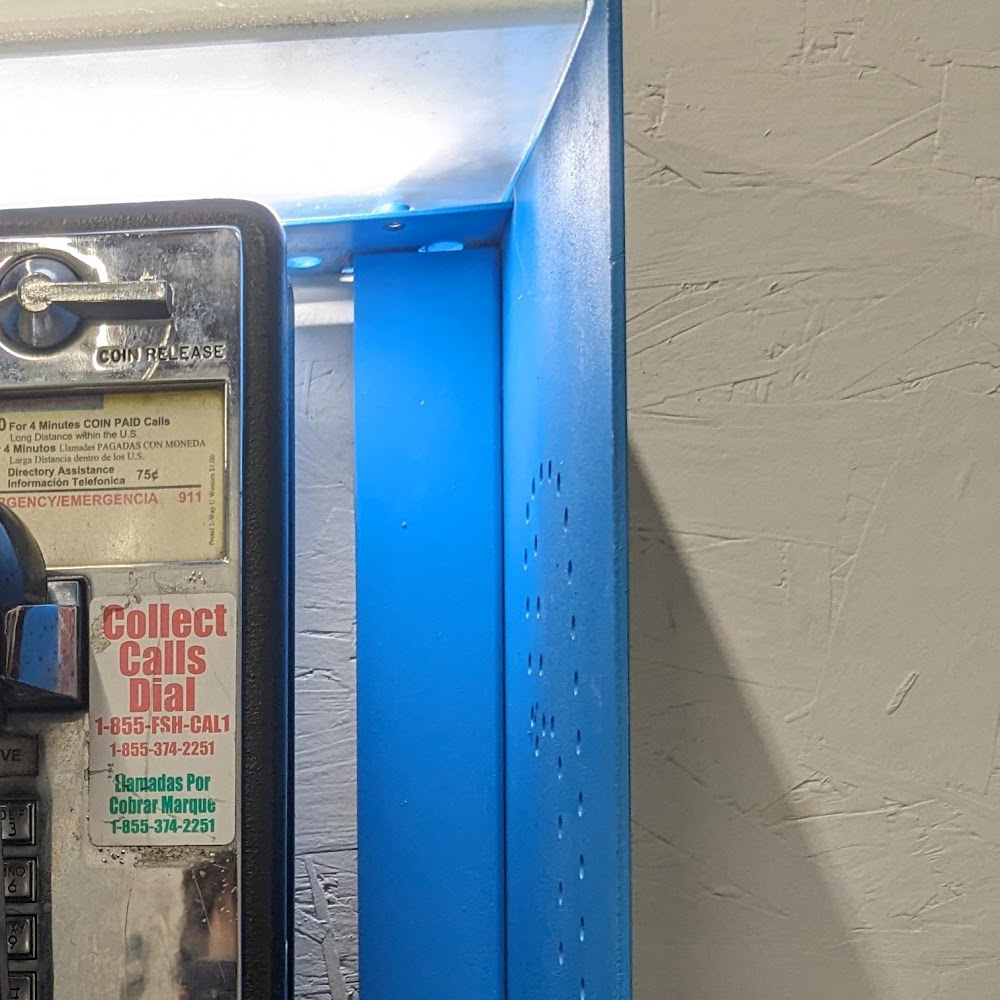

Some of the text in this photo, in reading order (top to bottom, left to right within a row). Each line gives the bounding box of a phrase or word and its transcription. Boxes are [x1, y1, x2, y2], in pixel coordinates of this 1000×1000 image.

[98, 345, 226, 363] COIN RELEASE
[9, 422, 27, 431] For
[29, 421, 36, 430] 4
[39, 419, 80, 430] Minutes
[83, 419, 111, 429] COIN
[114, 418, 141, 428] PAID
[144, 417, 170, 426] Calls
[10, 429, 139, 443] Long Distance within the U.S.
[4, 444, 10, 454] 4
[12, 444, 56, 453] Minutos
[59, 443, 95, 452] Llamadas
[97, 441, 141, 450] PAGADAS
[143, 440, 163, 450] CON
[165, 439, 206, 448] MONEDA
[9, 452, 125, 466] Larga Distancia dentro de los
[8, 465, 159, 482] Directory Assistance 75¢
[8, 476, 126, 488] Información Telefonica
[178, 492, 202, 503] 911
[103, 603, 228, 640] Collect
[119, 640, 206, 677] Calls
[129, 677, 196, 713] Dial
[95, 714, 230, 736] 1-855-FSH-CAL1
[110, 741, 215, 757] 1-855-374-2251
[114, 773, 211, 793] Llamadas Por
[109, 796, 216, 816] Cobrar Marque
[8, 822, 16, 836] 3
[111, 818, 215, 834] 1-855-374-2251
[8, 879, 18, 894] 6
[8, 935, 18, 950] 9
